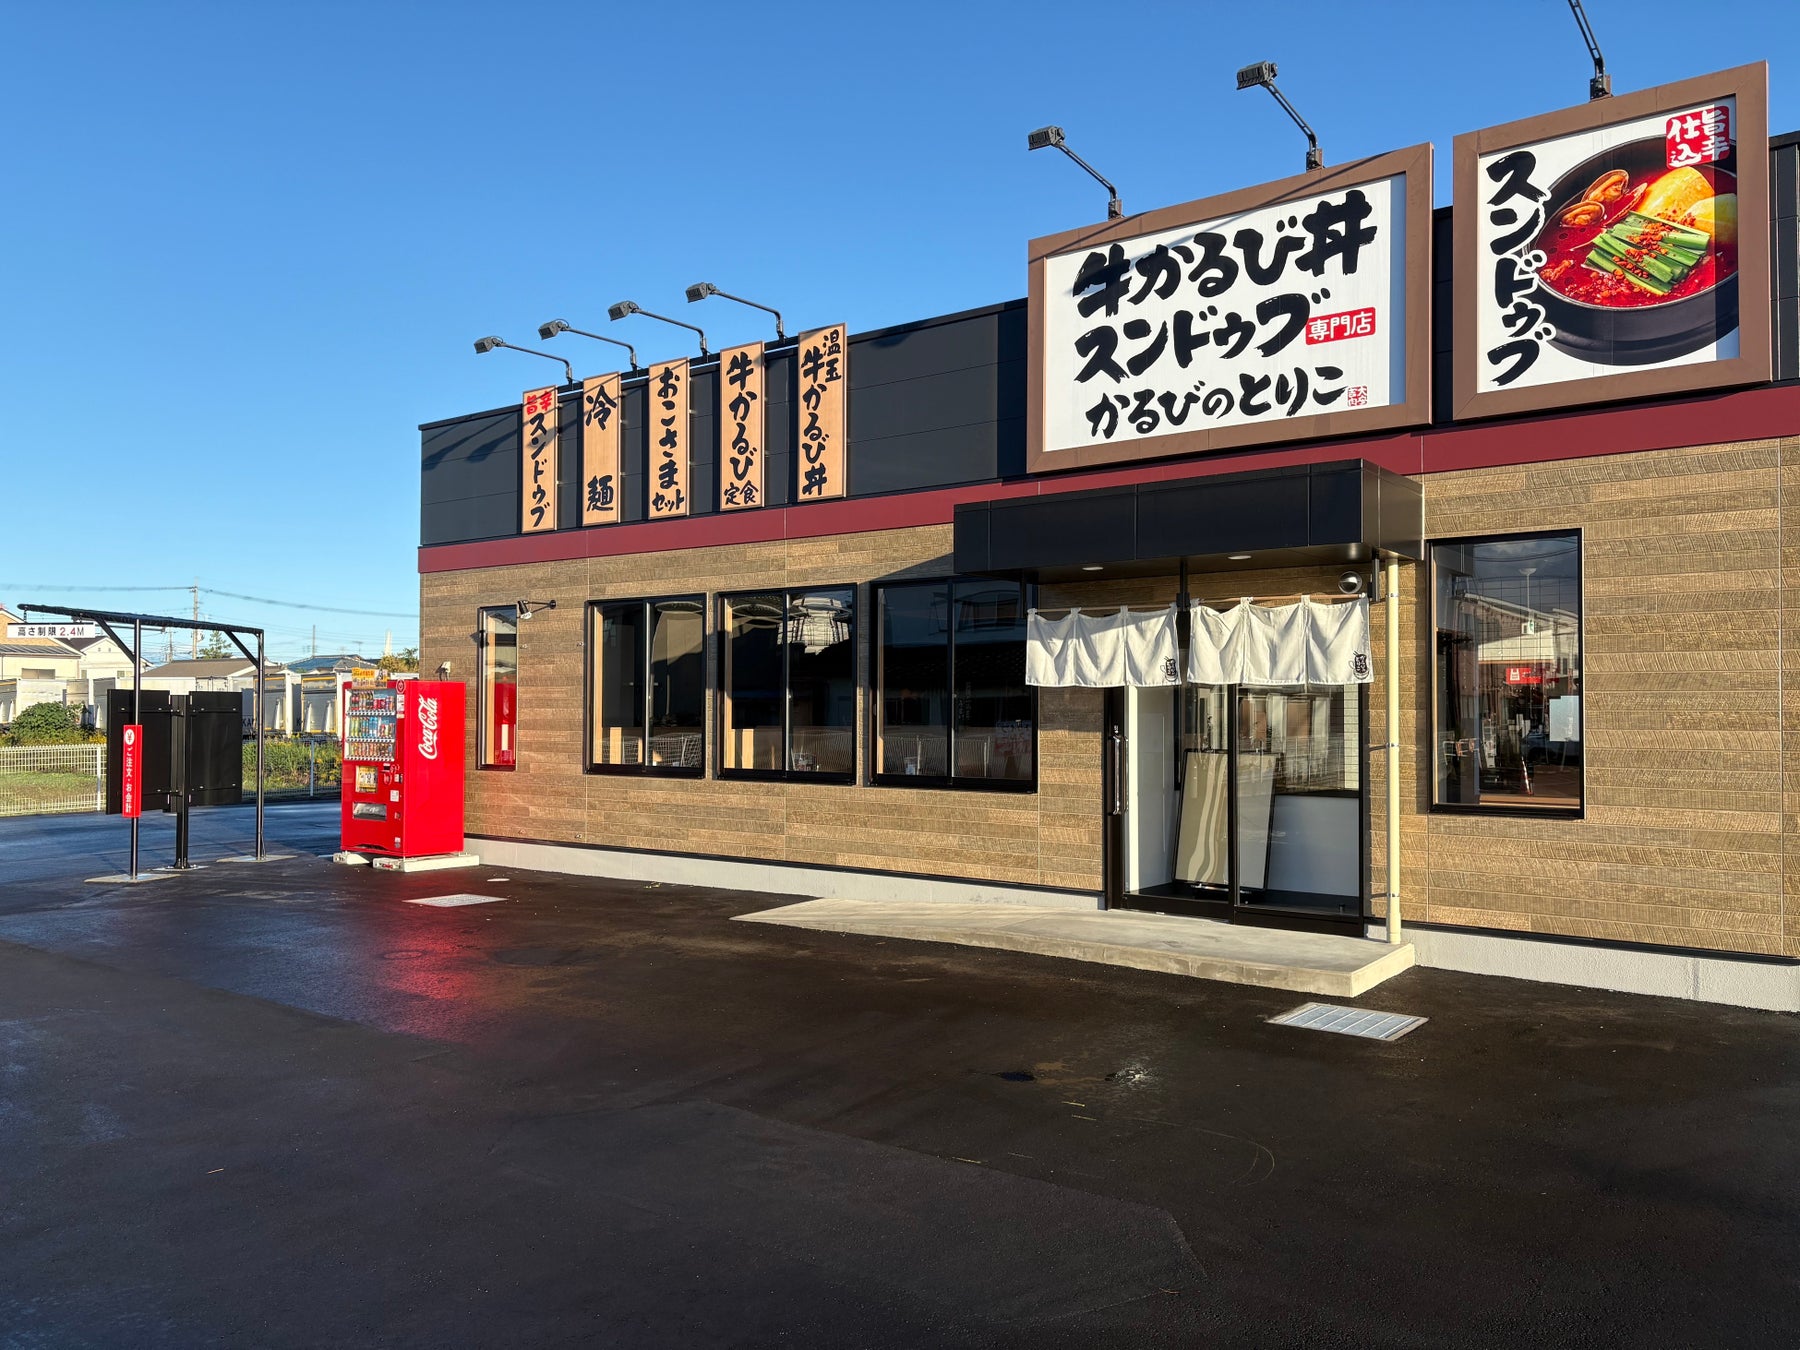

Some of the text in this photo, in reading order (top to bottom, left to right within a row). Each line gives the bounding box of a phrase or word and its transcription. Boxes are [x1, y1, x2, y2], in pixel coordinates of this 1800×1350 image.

[1667, 115, 1701, 168] 仕込
[1072, 190, 1377, 317] 牛かるび丼
[1486, 151, 1552, 386] スンドゥブ
[823, 329, 842, 382] 温玉
[1074, 288, 1331, 383] スンドゥブ
[1309, 311, 1373, 341] 専門店
[657, 366, 680, 489] おこさま
[726, 352, 758, 481] 牛かるび
[801, 345, 830, 496] 牛かるび丼
[1085, 366, 1349, 439] かるびのとりこ
[529, 412, 551, 528] スンドゥブ
[652, 488, 685, 512] セット
[723, 479, 759, 506] 定食
[418, 693, 438, 760] Coca-Cola
